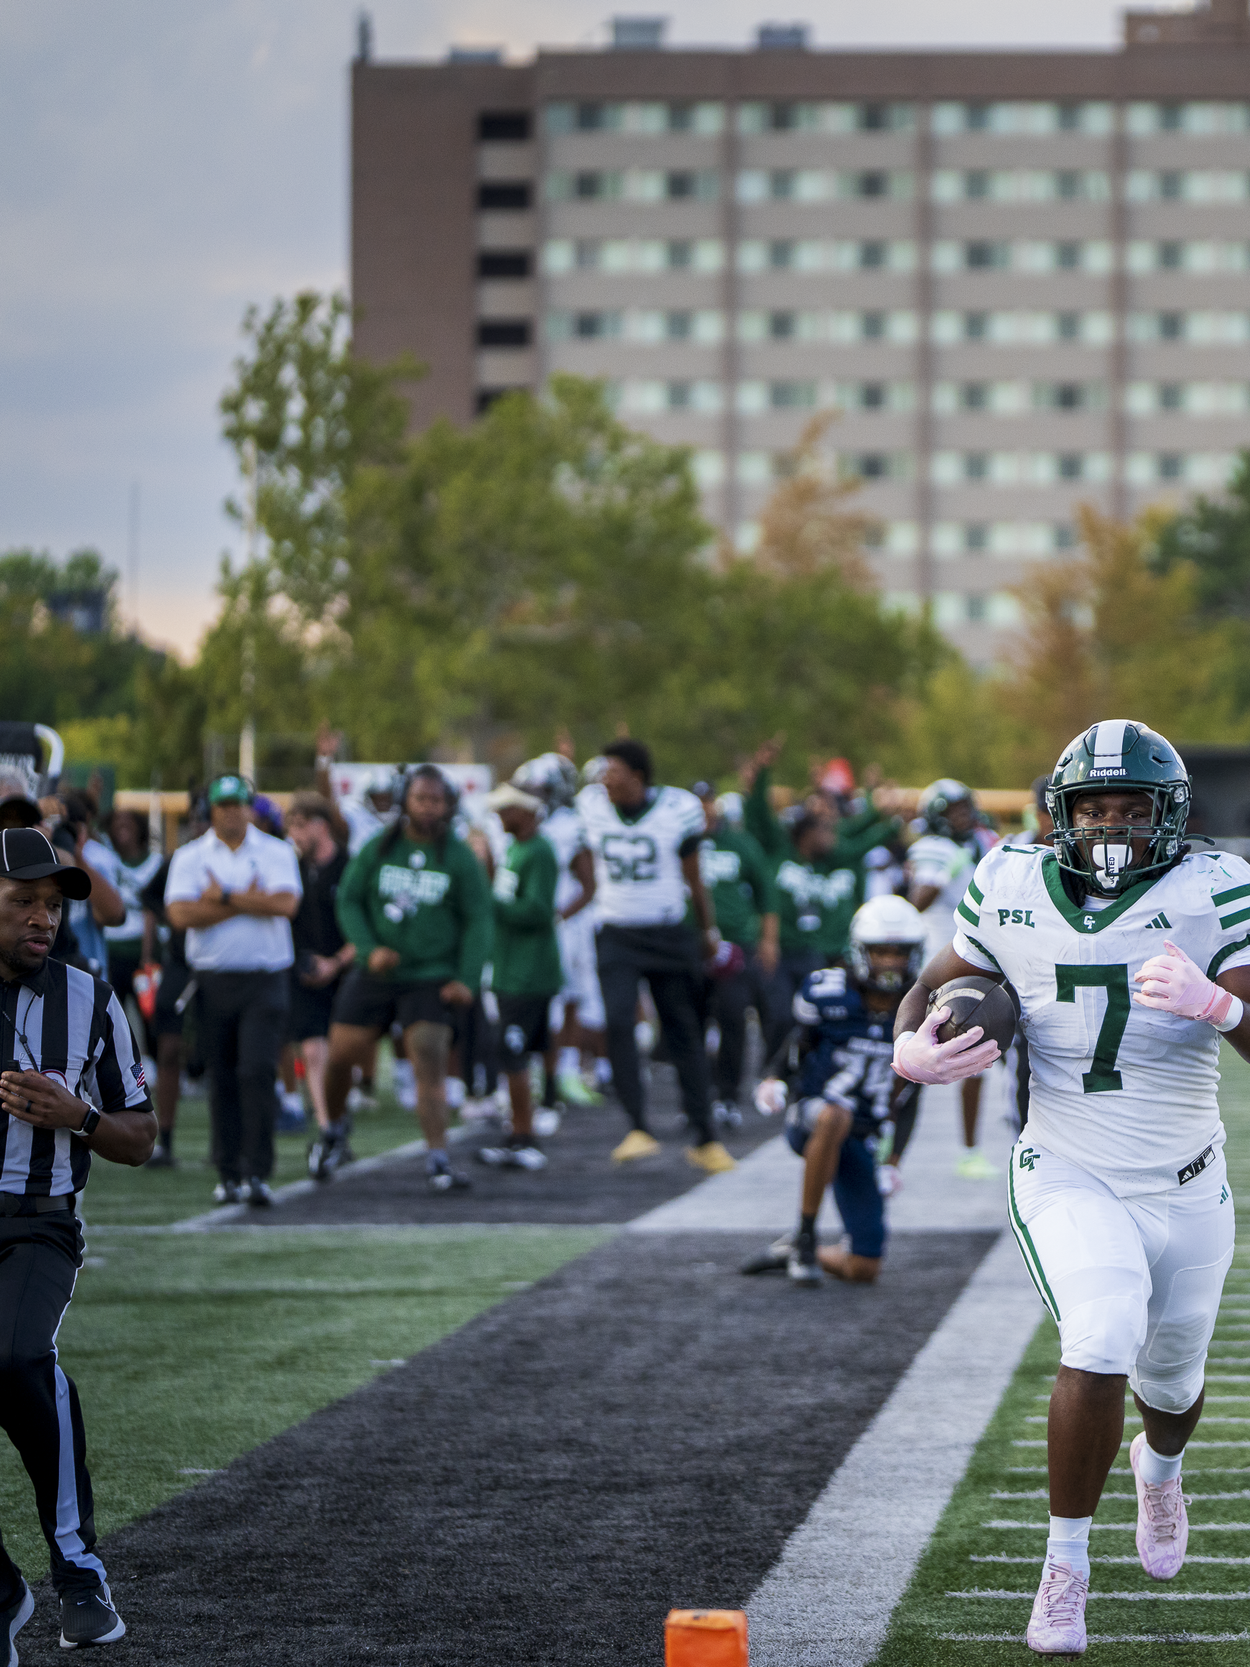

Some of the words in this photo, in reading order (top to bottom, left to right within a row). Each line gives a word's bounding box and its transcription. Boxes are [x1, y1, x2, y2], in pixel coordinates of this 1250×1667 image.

[1089, 768, 1127, 777] Riddell
[997, 908, 1036, 929] PSL
[1055, 963, 1131, 1094] 7
